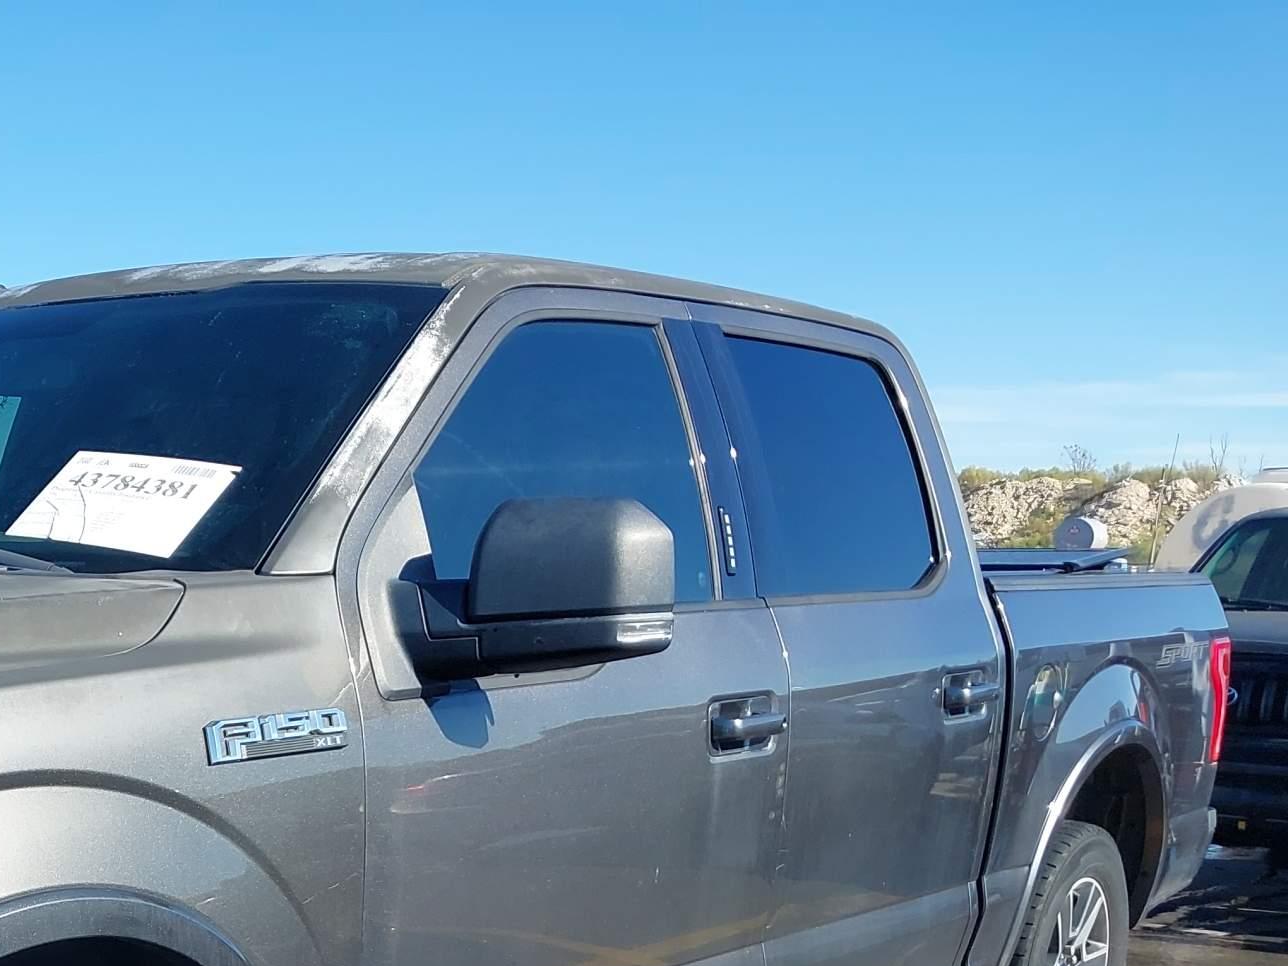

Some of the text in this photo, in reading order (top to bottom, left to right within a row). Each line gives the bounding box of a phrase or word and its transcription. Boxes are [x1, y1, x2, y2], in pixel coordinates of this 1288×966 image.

[68, 471, 198, 499] 43784381
[1155, 641, 1209, 669] SPORT
[314, 734, 345, 748] XLT
